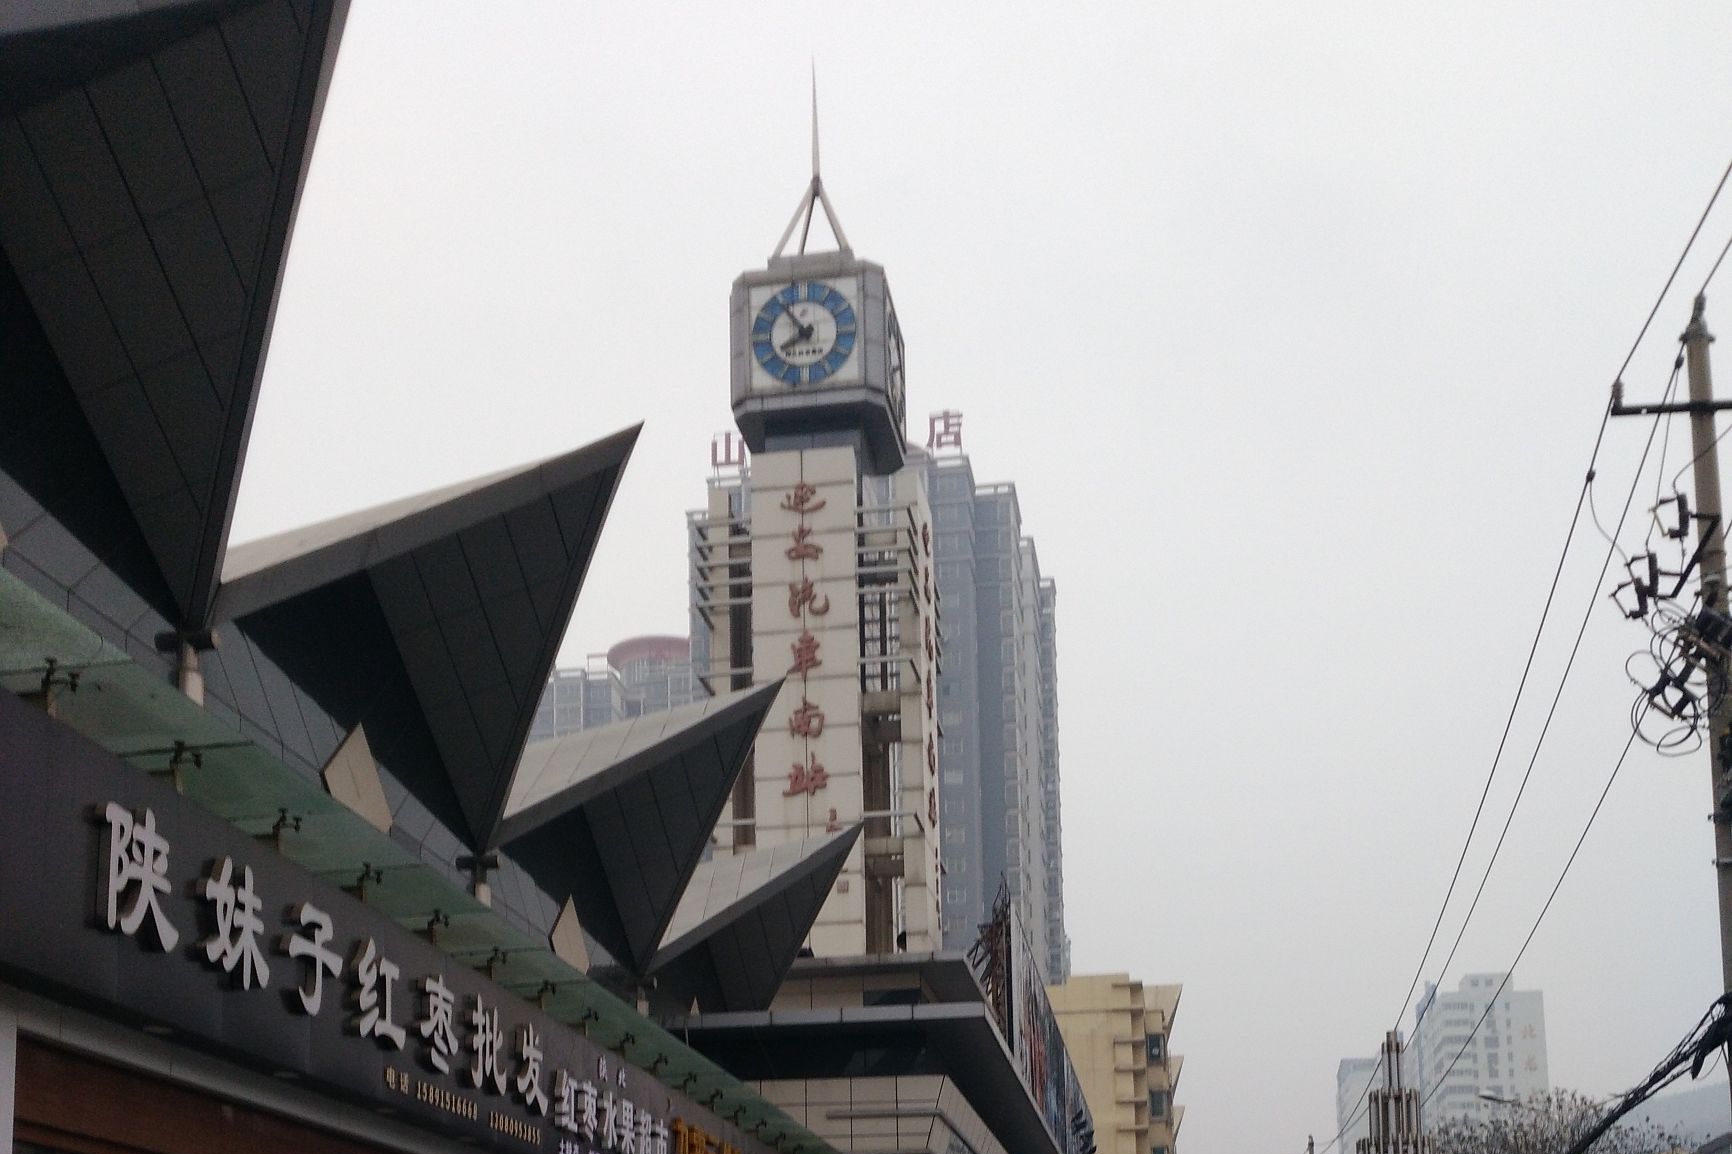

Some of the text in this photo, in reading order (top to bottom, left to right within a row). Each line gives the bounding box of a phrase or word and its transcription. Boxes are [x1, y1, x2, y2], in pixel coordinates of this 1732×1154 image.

[710, 410, 963, 467] 山 店
[103, 802, 549, 1116] 陕妹子红枣批发
[385, 1066, 410, 1095] 电话
